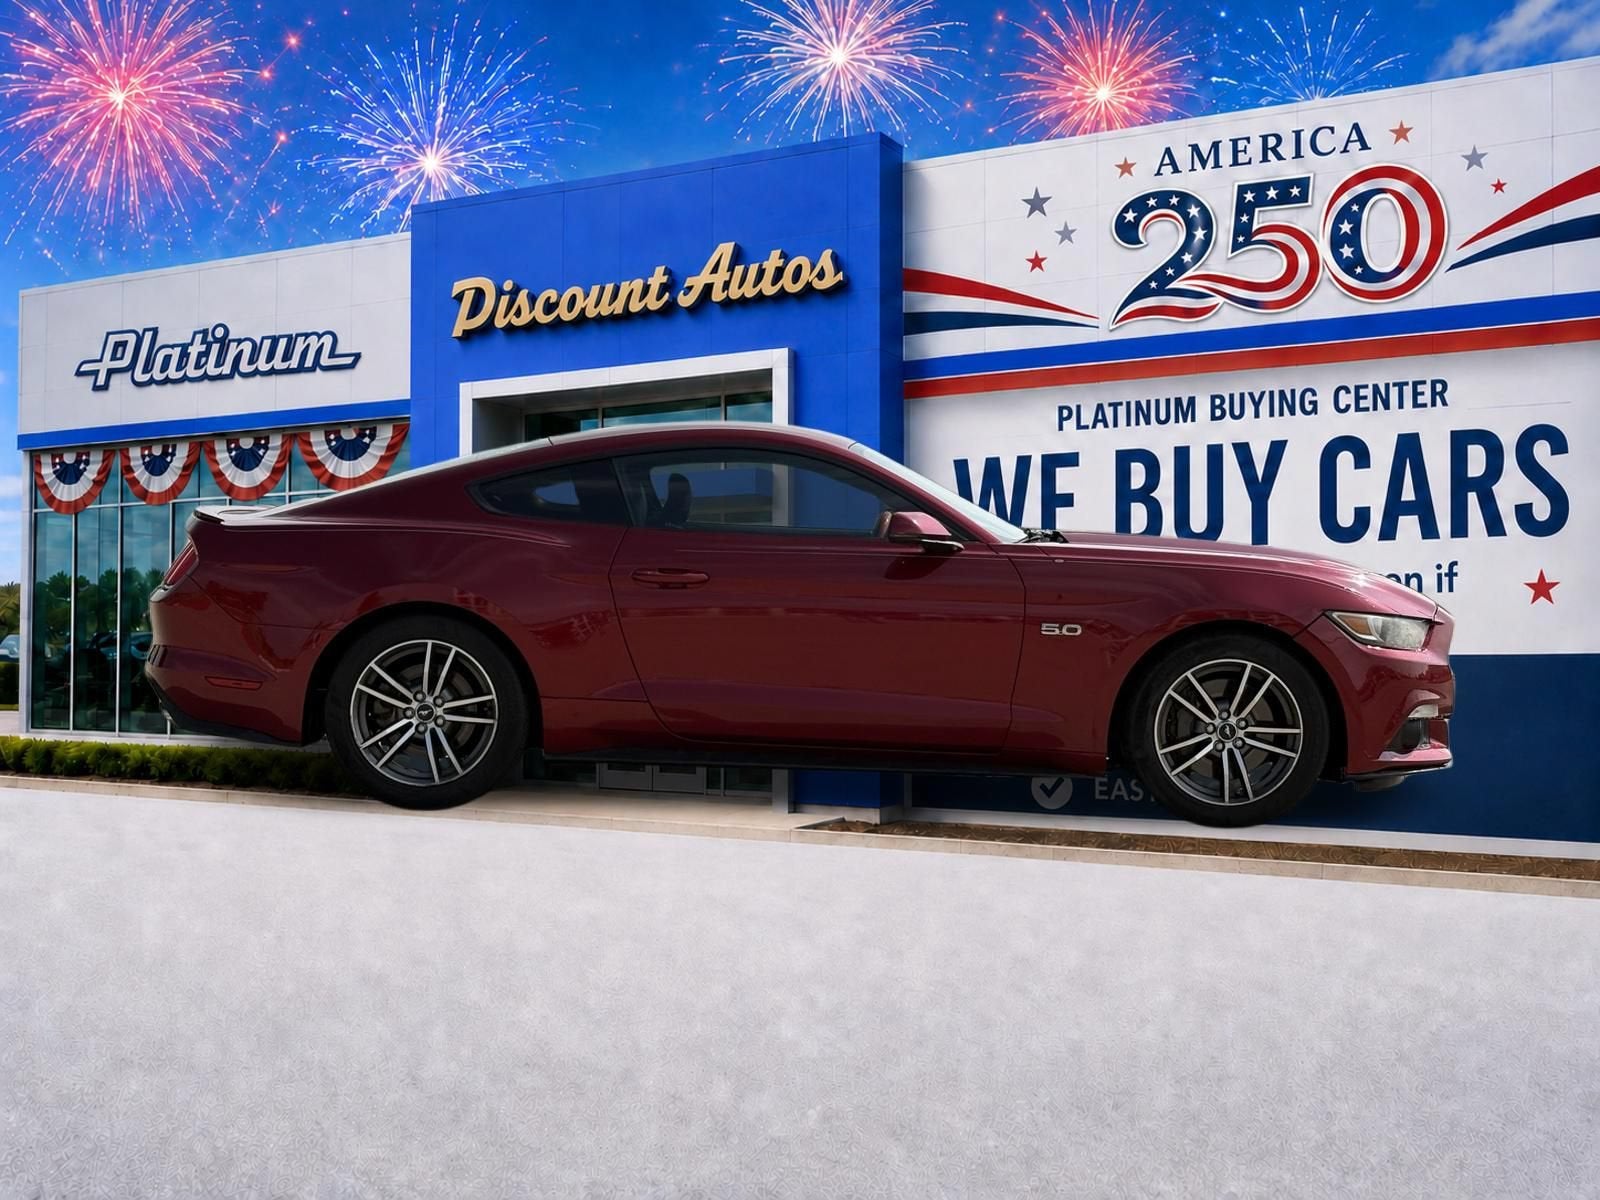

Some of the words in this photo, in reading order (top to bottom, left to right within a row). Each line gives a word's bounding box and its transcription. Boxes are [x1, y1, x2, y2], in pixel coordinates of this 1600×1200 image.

[1154, 122, 1371, 176] AMERICA
[1109, 163, 1448, 331] 250
[451, 265, 669, 337] Discount
[677, 241, 843, 307] Autos
[75, 323, 361, 391] Platinum
[1057, 396, 1196, 431] PLATINUM
[1209, 387, 1318, 421] BUYING
[1333, 378, 1449, 414] CENTER
[1115, 440, 1288, 545] BUY
[1319, 423, 1570, 543] CARS
[1435, 561, 1458, 592] if
[1094, 777, 1155, 802] EAS
